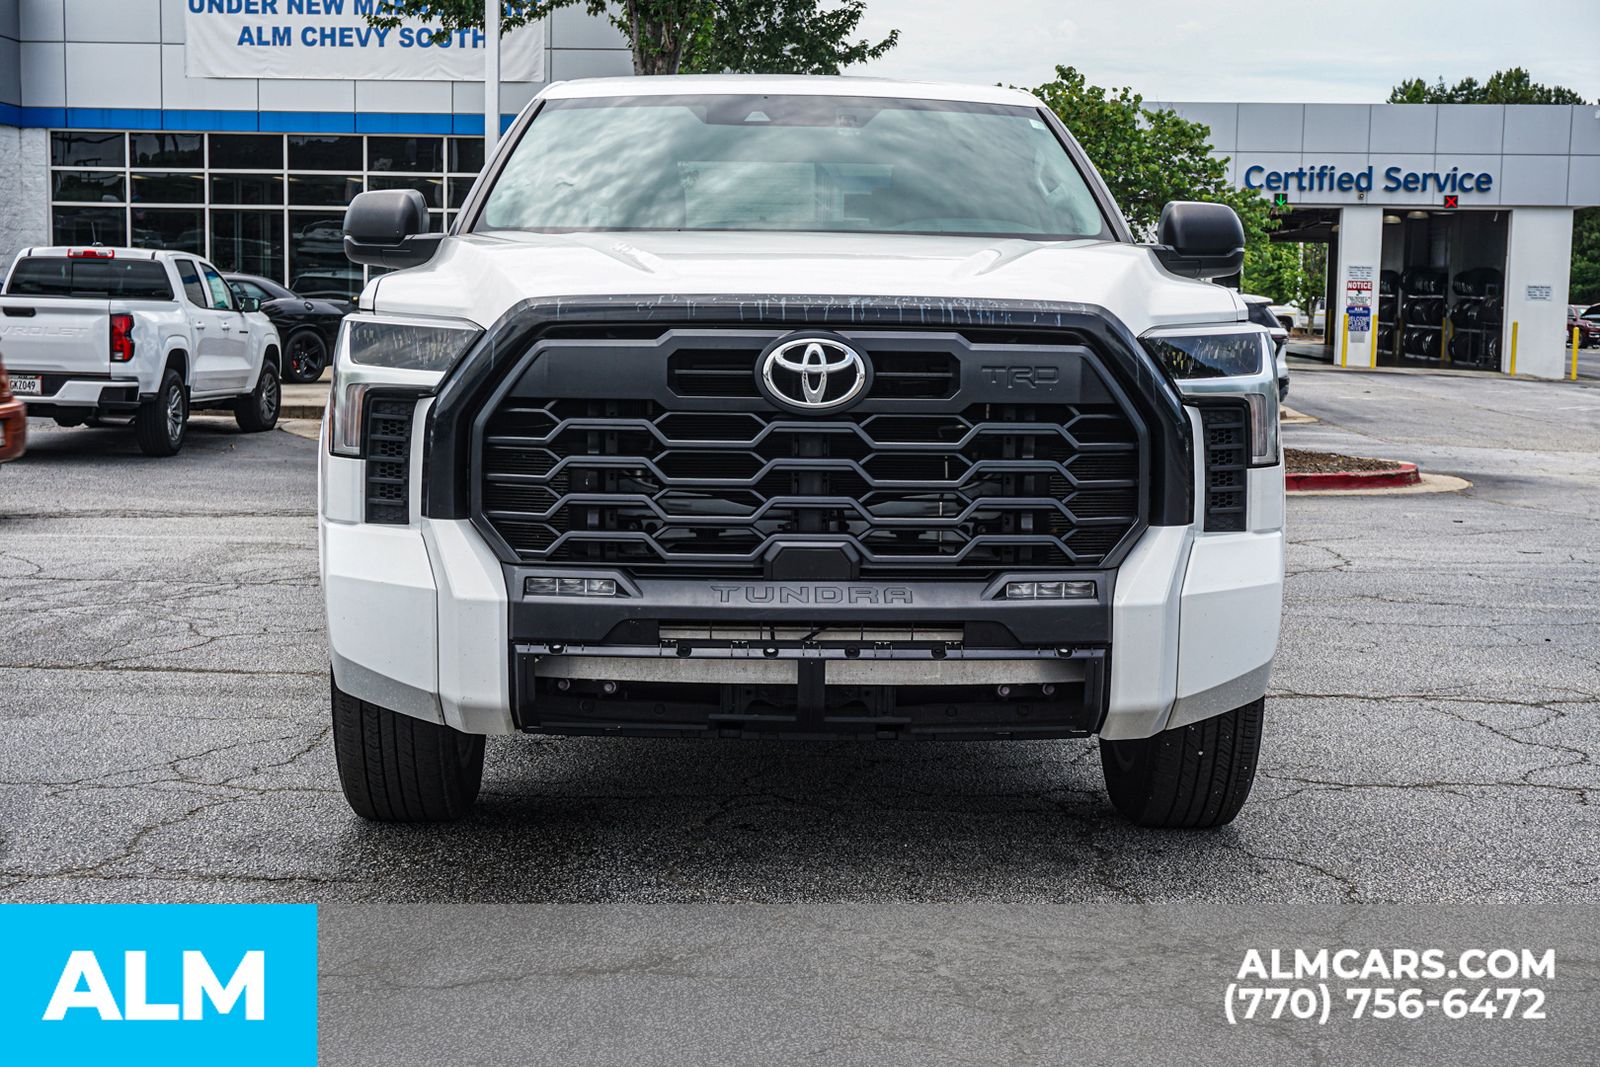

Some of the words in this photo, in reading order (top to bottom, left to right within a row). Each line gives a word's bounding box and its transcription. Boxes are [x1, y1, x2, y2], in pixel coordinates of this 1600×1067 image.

[188, 0, 279, 14] UNDER
[287, 0, 345, 15] NEW
[237, 26, 292, 46] ALM
[301, 26, 391, 47] CHEVY
[1244, 164, 1373, 192] Certified
[1383, 166, 1493, 193] Service
[981, 366, 1060, 389] TRD
[710, 586, 914, 604] TUNDRA
